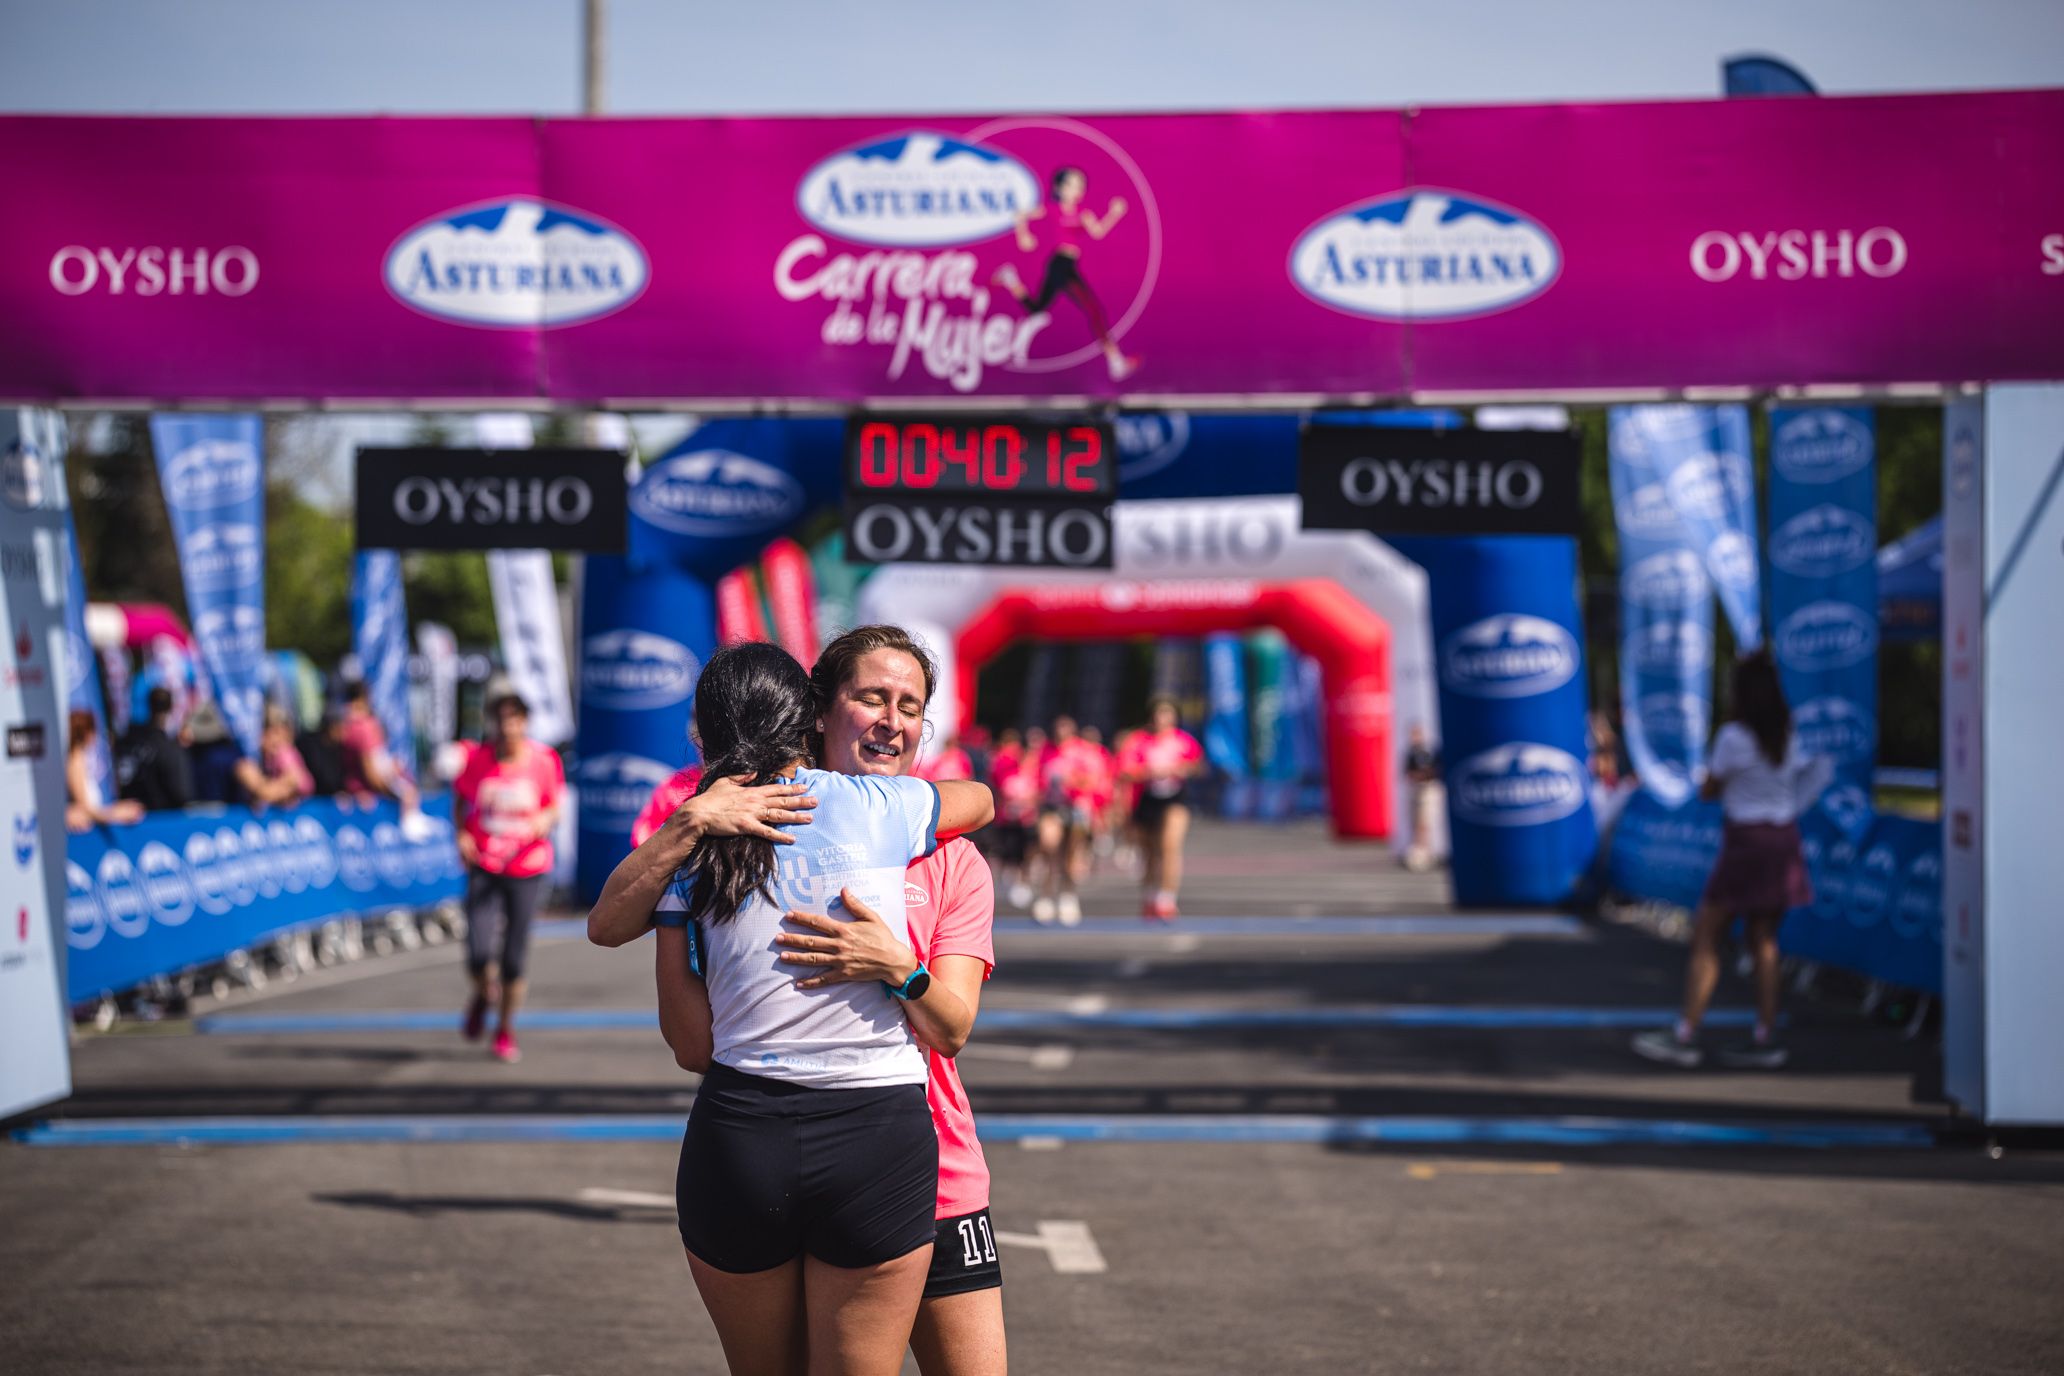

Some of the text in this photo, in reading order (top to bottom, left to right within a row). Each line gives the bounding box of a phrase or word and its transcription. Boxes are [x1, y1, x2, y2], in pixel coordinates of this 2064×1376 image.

[815, 175, 1018, 220] ASTURIANA
[48, 245, 260, 297] OYSHO
[405, 246, 625, 294] ASTURIANA
[773, 234, 979, 302] Carrera
[1311, 239, 1537, 287] ASTURIANA
[1689, 227, 1908, 282] OYSHO
[887, 288, 1052, 392] Mujer
[393, 476, 593, 524] OYSHO
[1340, 458, 1543, 508] OYSHO
[853, 503, 1108, 567] OYSHO
[958, 1216, 997, 1266] 11
